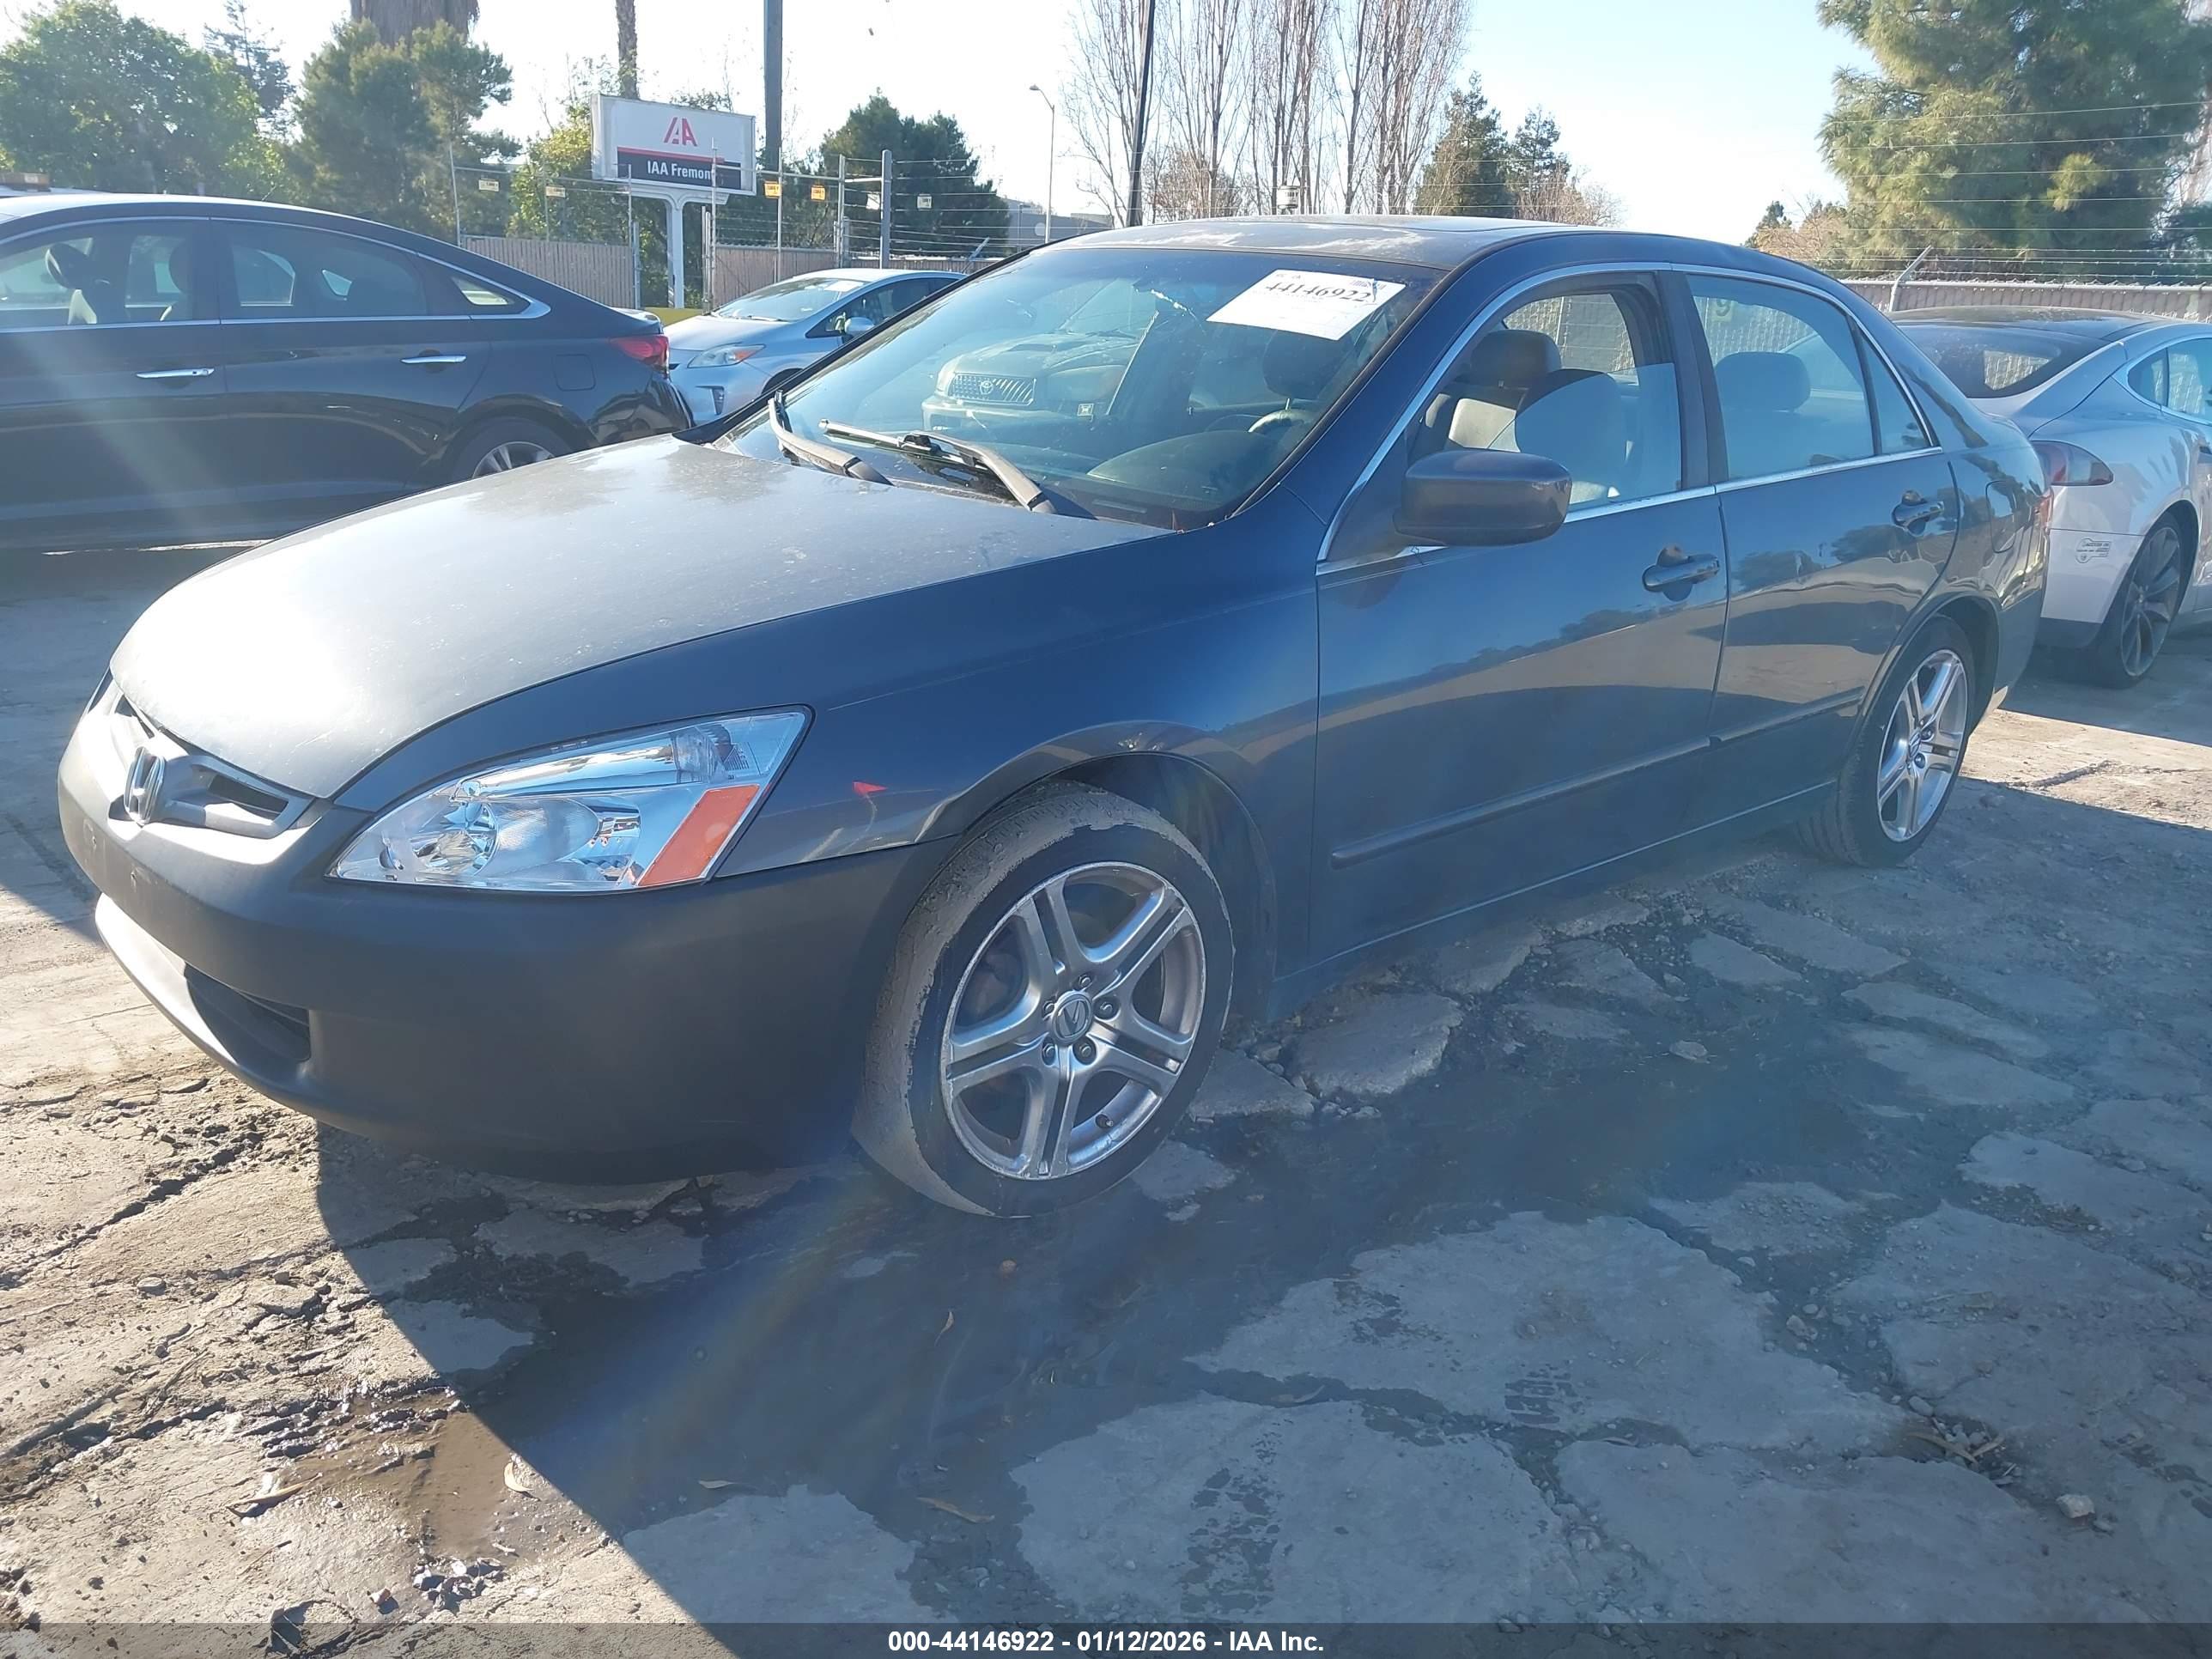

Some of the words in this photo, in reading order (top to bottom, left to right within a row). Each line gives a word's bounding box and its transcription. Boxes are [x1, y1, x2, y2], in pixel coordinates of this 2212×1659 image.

[647, 161, 669, 175] IAA
[671, 163, 717, 179] Fremon
[1266, 282, 1372, 302] 44146922
